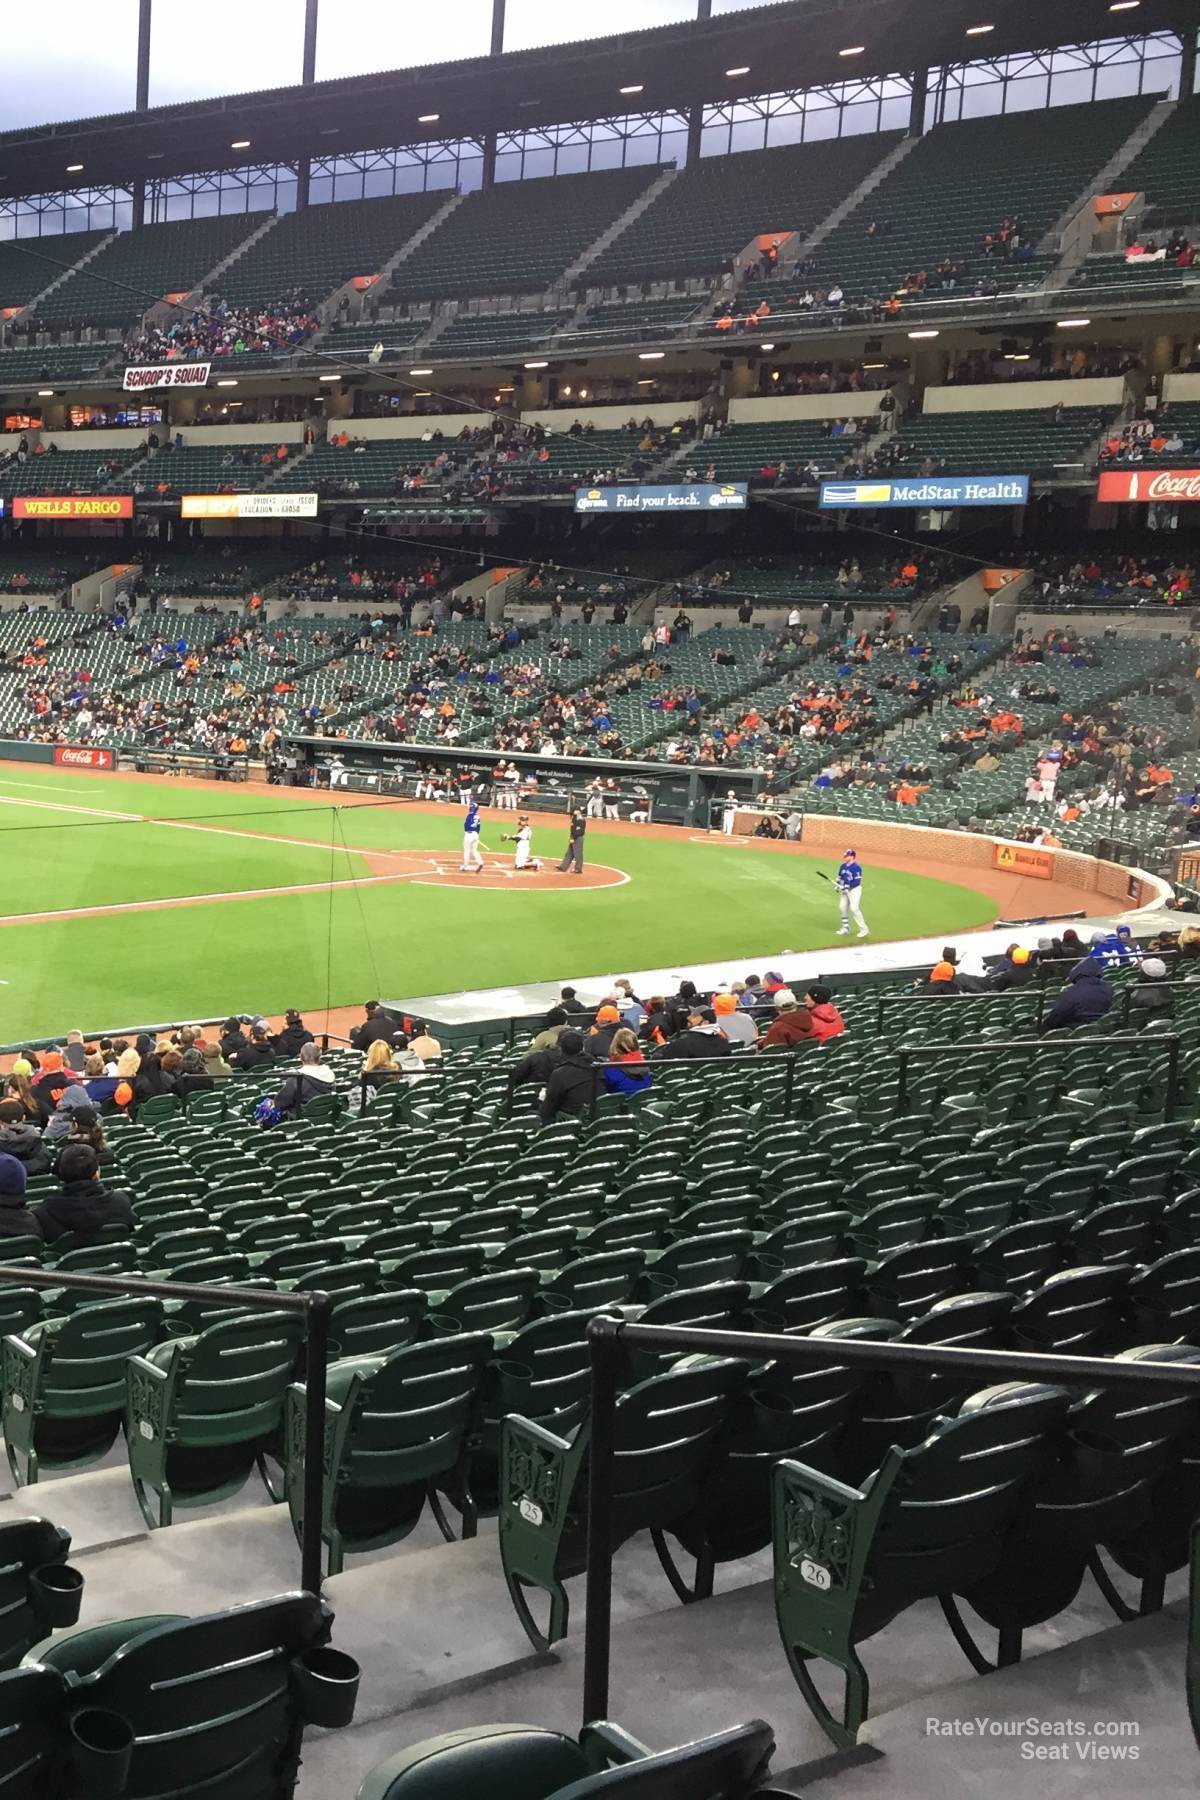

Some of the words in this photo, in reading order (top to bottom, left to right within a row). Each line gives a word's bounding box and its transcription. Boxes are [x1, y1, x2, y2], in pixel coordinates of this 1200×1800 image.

[126, 369, 173, 387] SCHOOP'S
[174, 367, 208, 384] SQUAD
[893, 485, 962, 501] MedStar
[965, 482, 1023, 499] Health
[25, 501, 71, 514] WELLS
[74, 502, 121, 514] FARGO
[616, 494, 640, 507] Find
[641, 496, 664, 510] your
[62, 748, 94, 764] Coca-Cola
[524, 1503, 538, 1521] 25
[807, 1564, 825, 1585] 26
